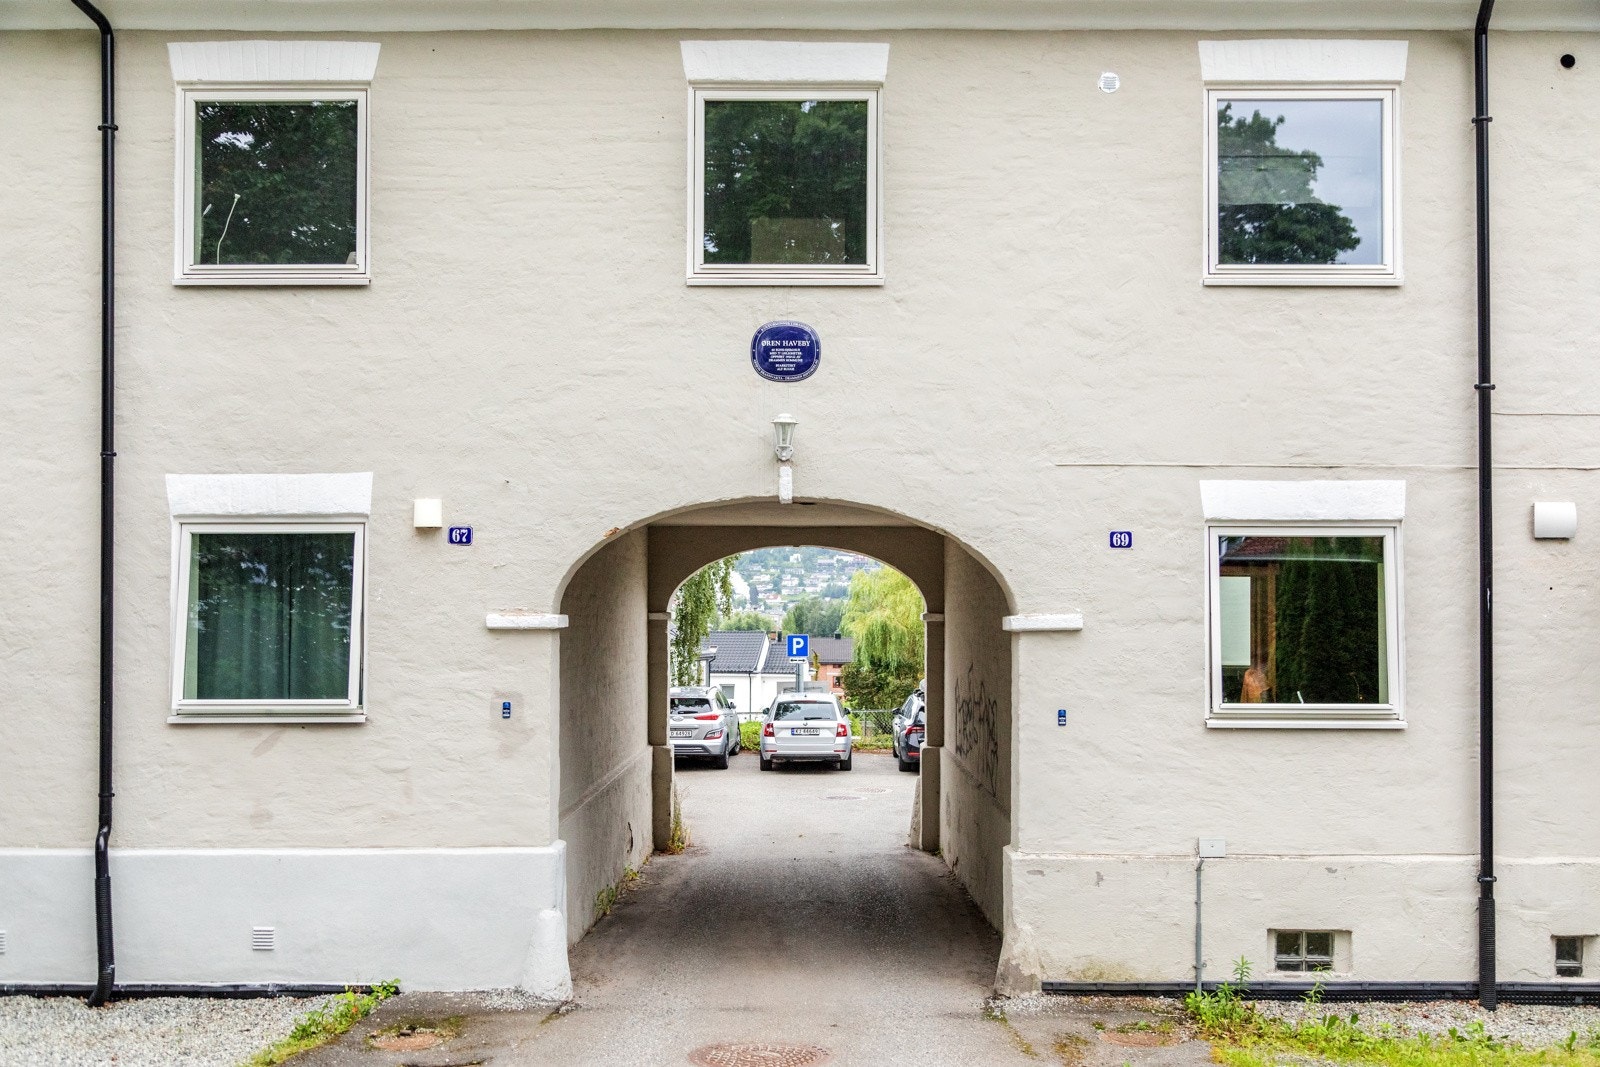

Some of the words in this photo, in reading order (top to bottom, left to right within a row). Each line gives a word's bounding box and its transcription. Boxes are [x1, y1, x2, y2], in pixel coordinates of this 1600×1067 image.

[452, 528, 468, 542] 67
[1112, 532, 1129, 547] 69
[792, 637, 805, 655] P
